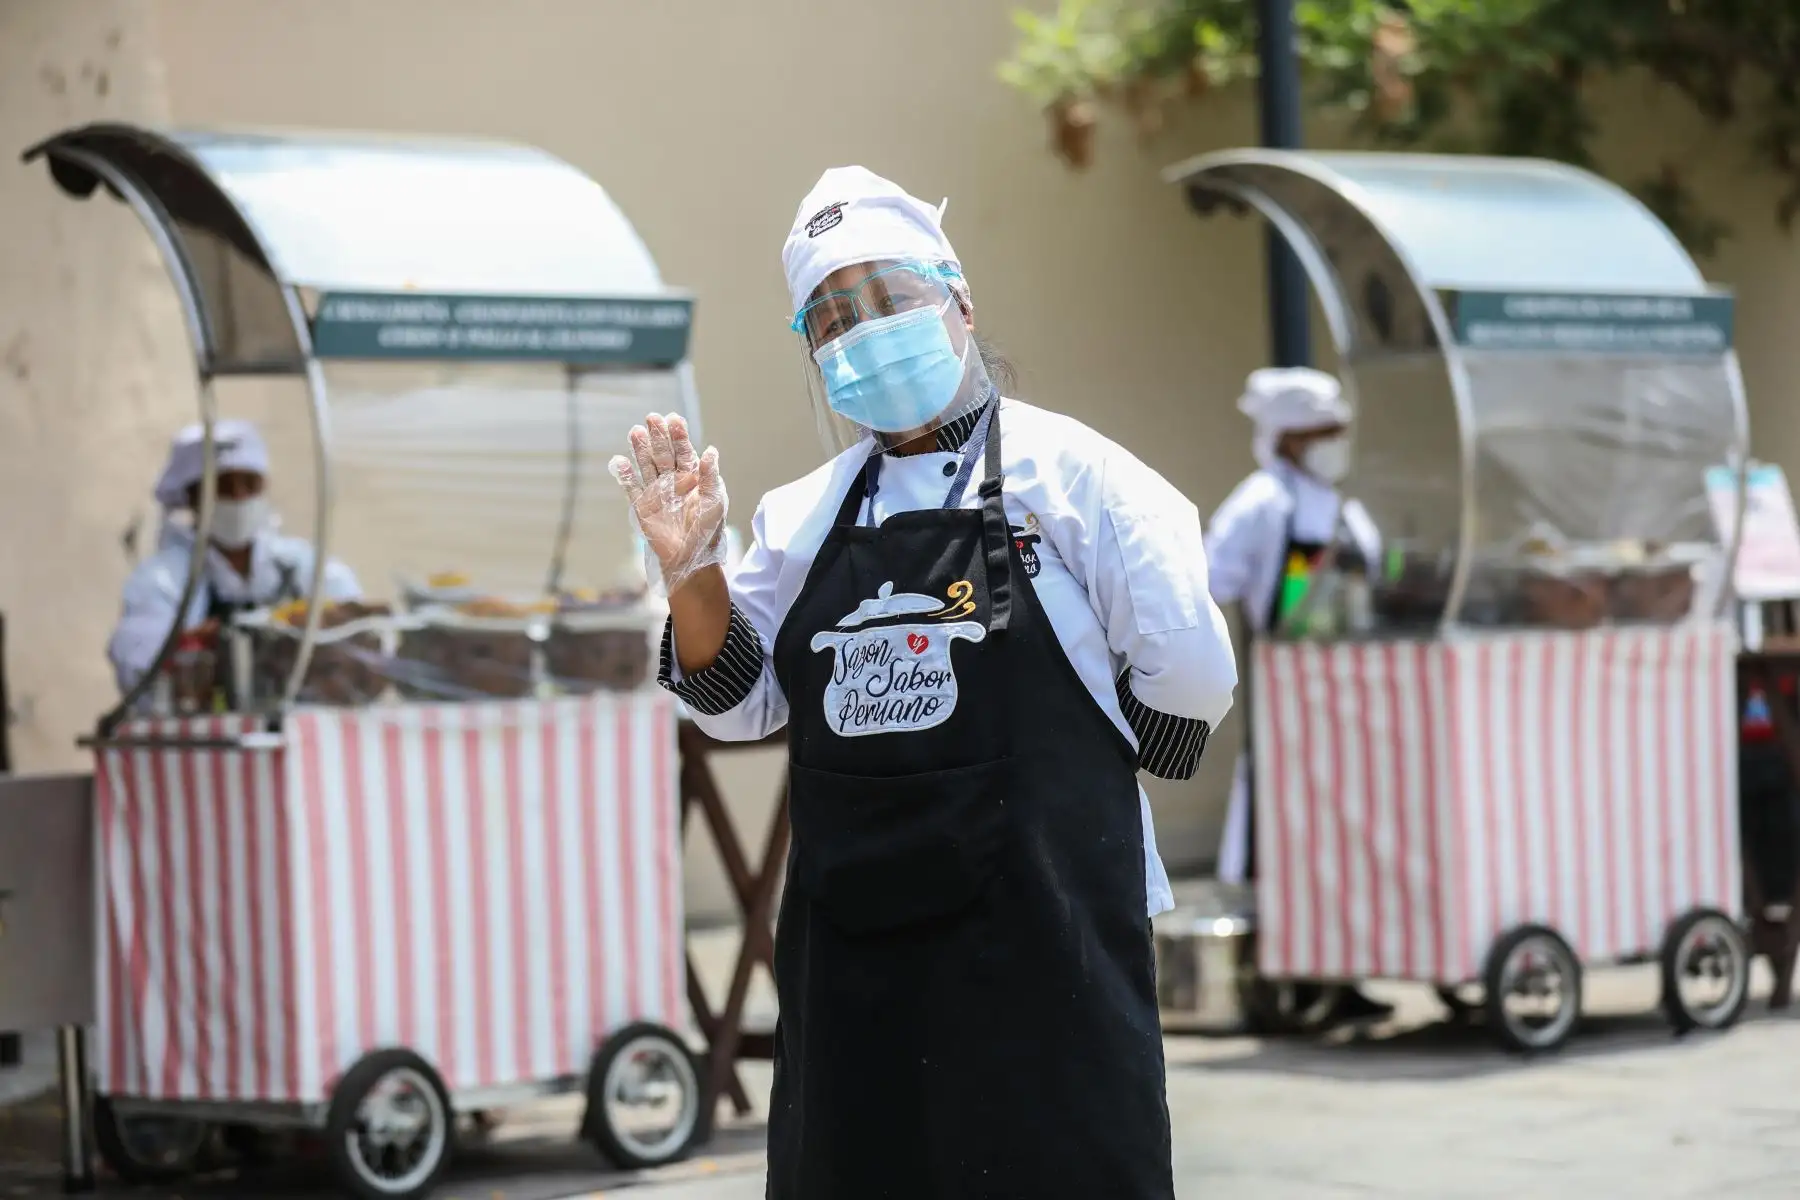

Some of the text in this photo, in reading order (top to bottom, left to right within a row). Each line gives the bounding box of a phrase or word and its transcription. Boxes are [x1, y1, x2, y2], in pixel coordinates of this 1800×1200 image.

[834, 638, 893, 685] Sazón
[866, 658, 951, 697] Sabor
[839, 689, 944, 732] Peruano
